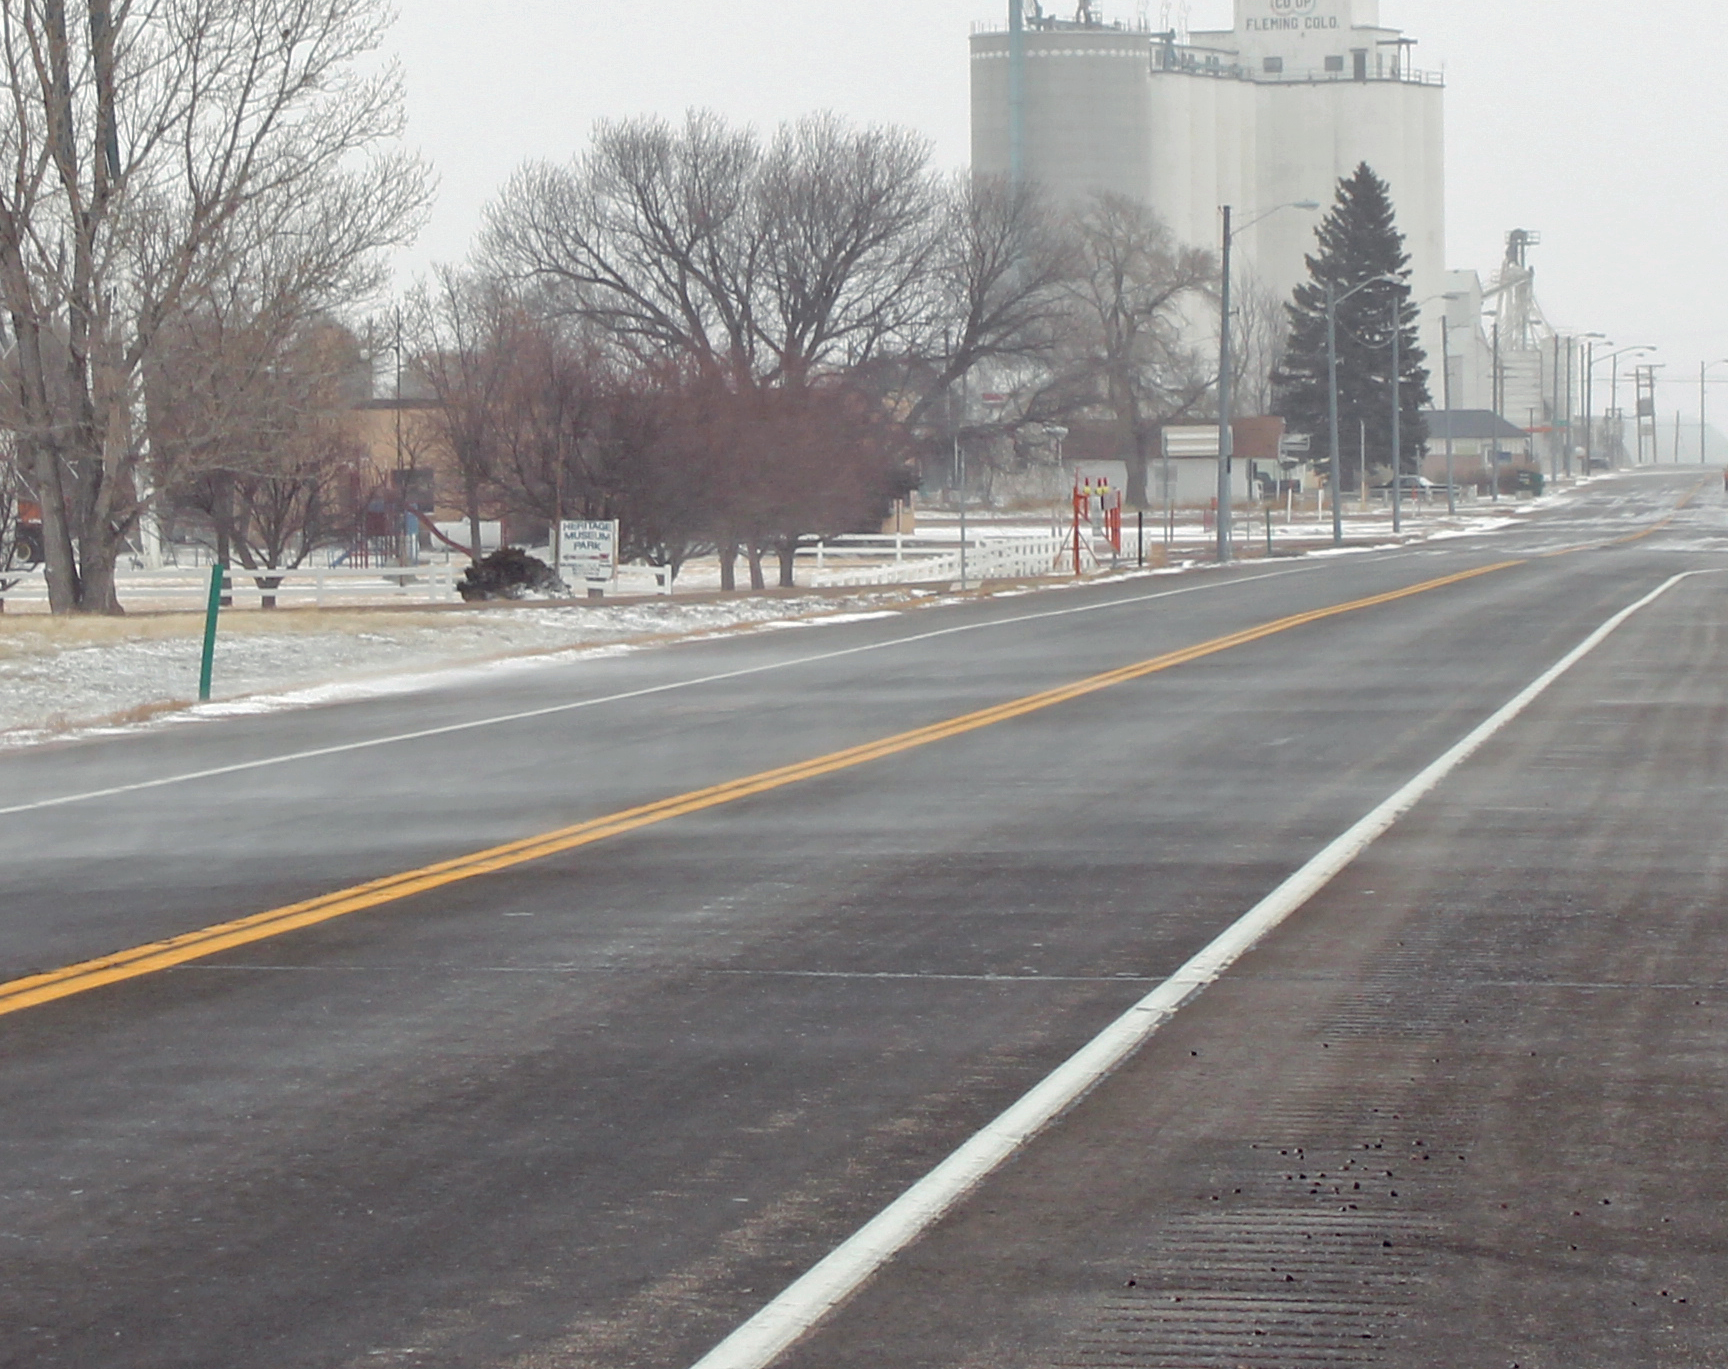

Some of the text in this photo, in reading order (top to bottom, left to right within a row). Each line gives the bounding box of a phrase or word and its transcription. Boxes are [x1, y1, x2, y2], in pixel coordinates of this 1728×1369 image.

[1246, 16, 1340, 30] FLEMING COLO.
[563, 522, 611, 531] HERITAGE
[564, 531, 611, 540] MUSEUM
[574, 541, 601, 550] PARK
